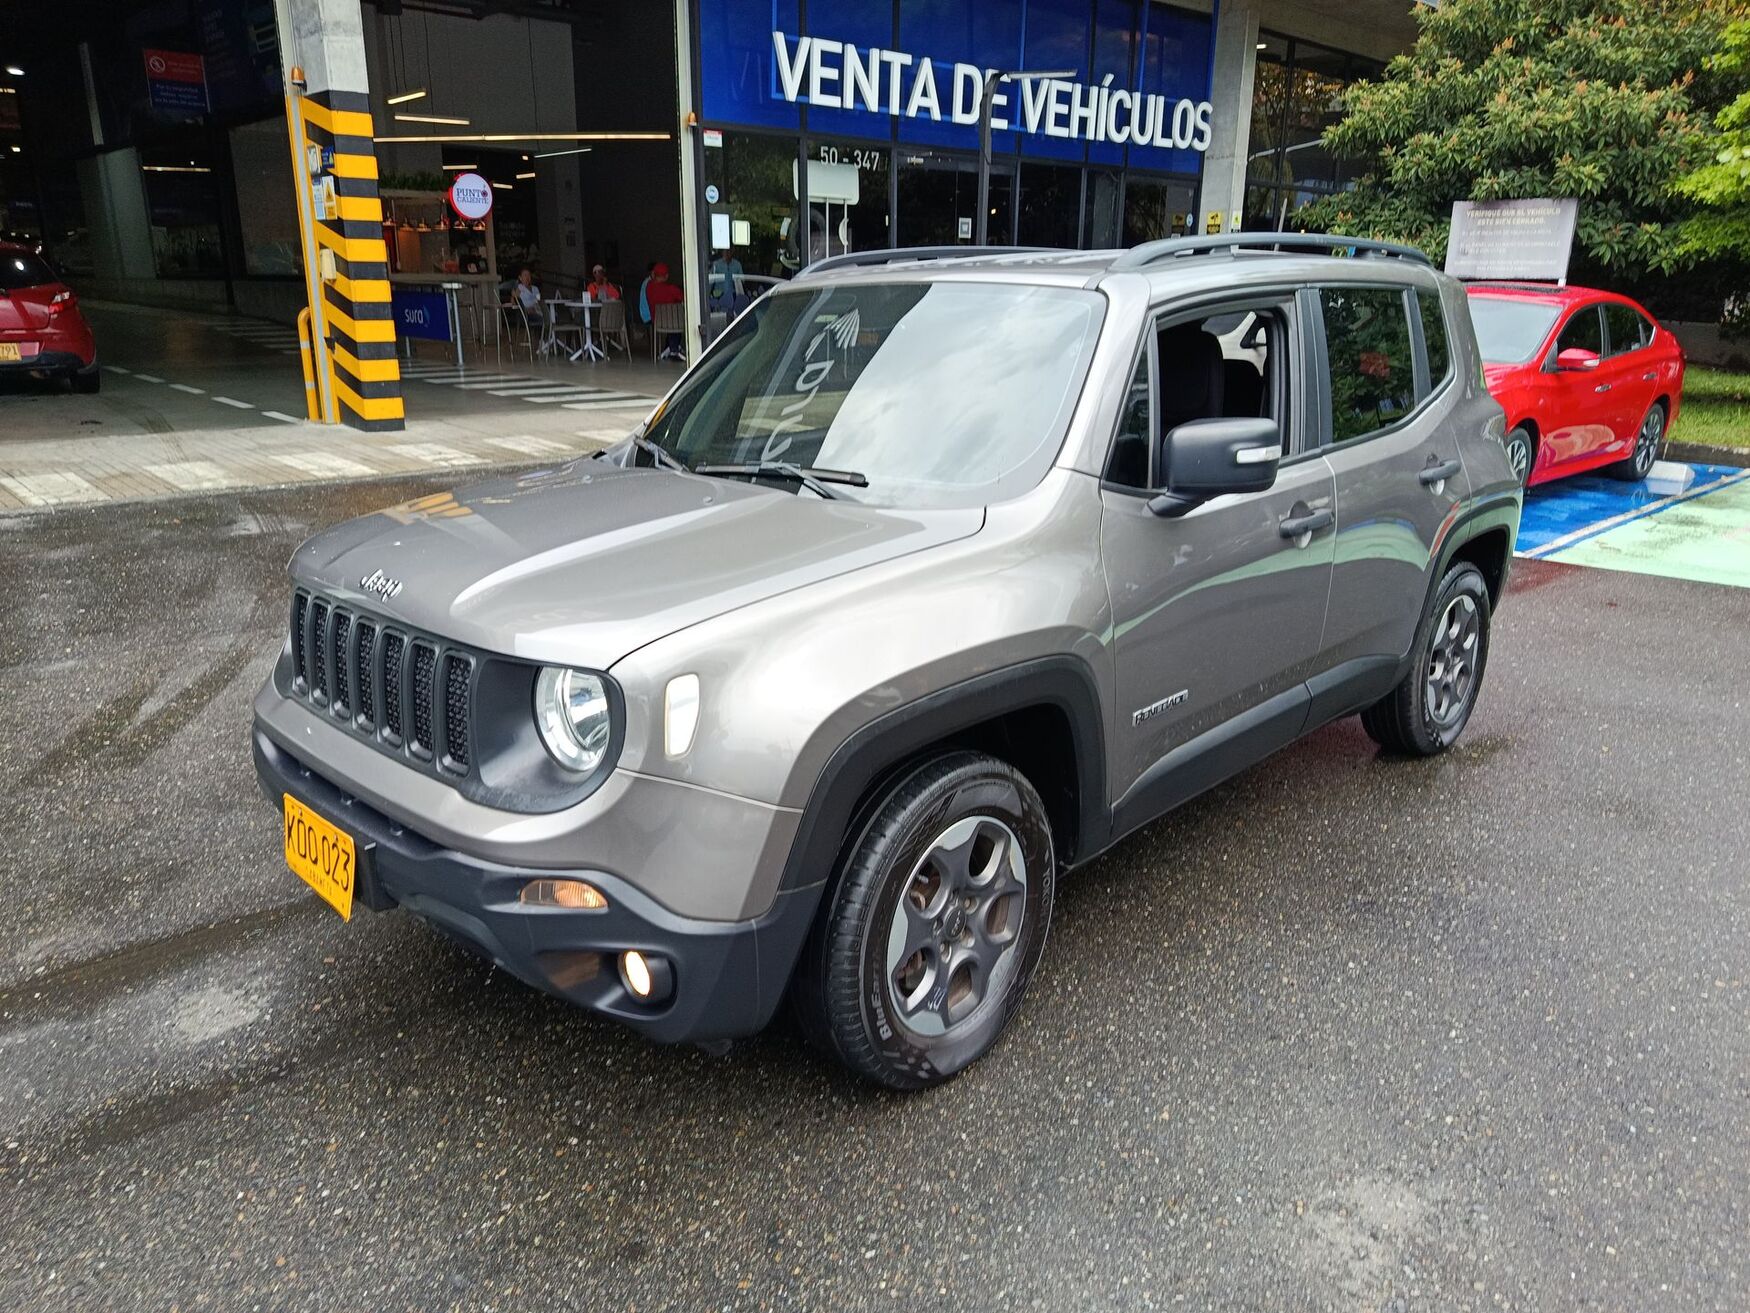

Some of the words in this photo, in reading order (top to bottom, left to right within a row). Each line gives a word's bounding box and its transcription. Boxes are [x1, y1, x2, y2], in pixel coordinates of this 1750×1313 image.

[772, 31, 942, 121] VENTA
[952, 62, 1012, 130] DE
[1020, 73, 1213, 152] VEHÍCULOS
[820, 145, 838, 166] 50
[853, 149, 880, 171] 347
[456, 188, 488, 198] PUNTO
[404, 308, 424, 324] sura
[359, 568, 403, 603] Jeep
[1132, 689, 1189, 727] RENEGADE
[322, 835, 350, 892] 023
